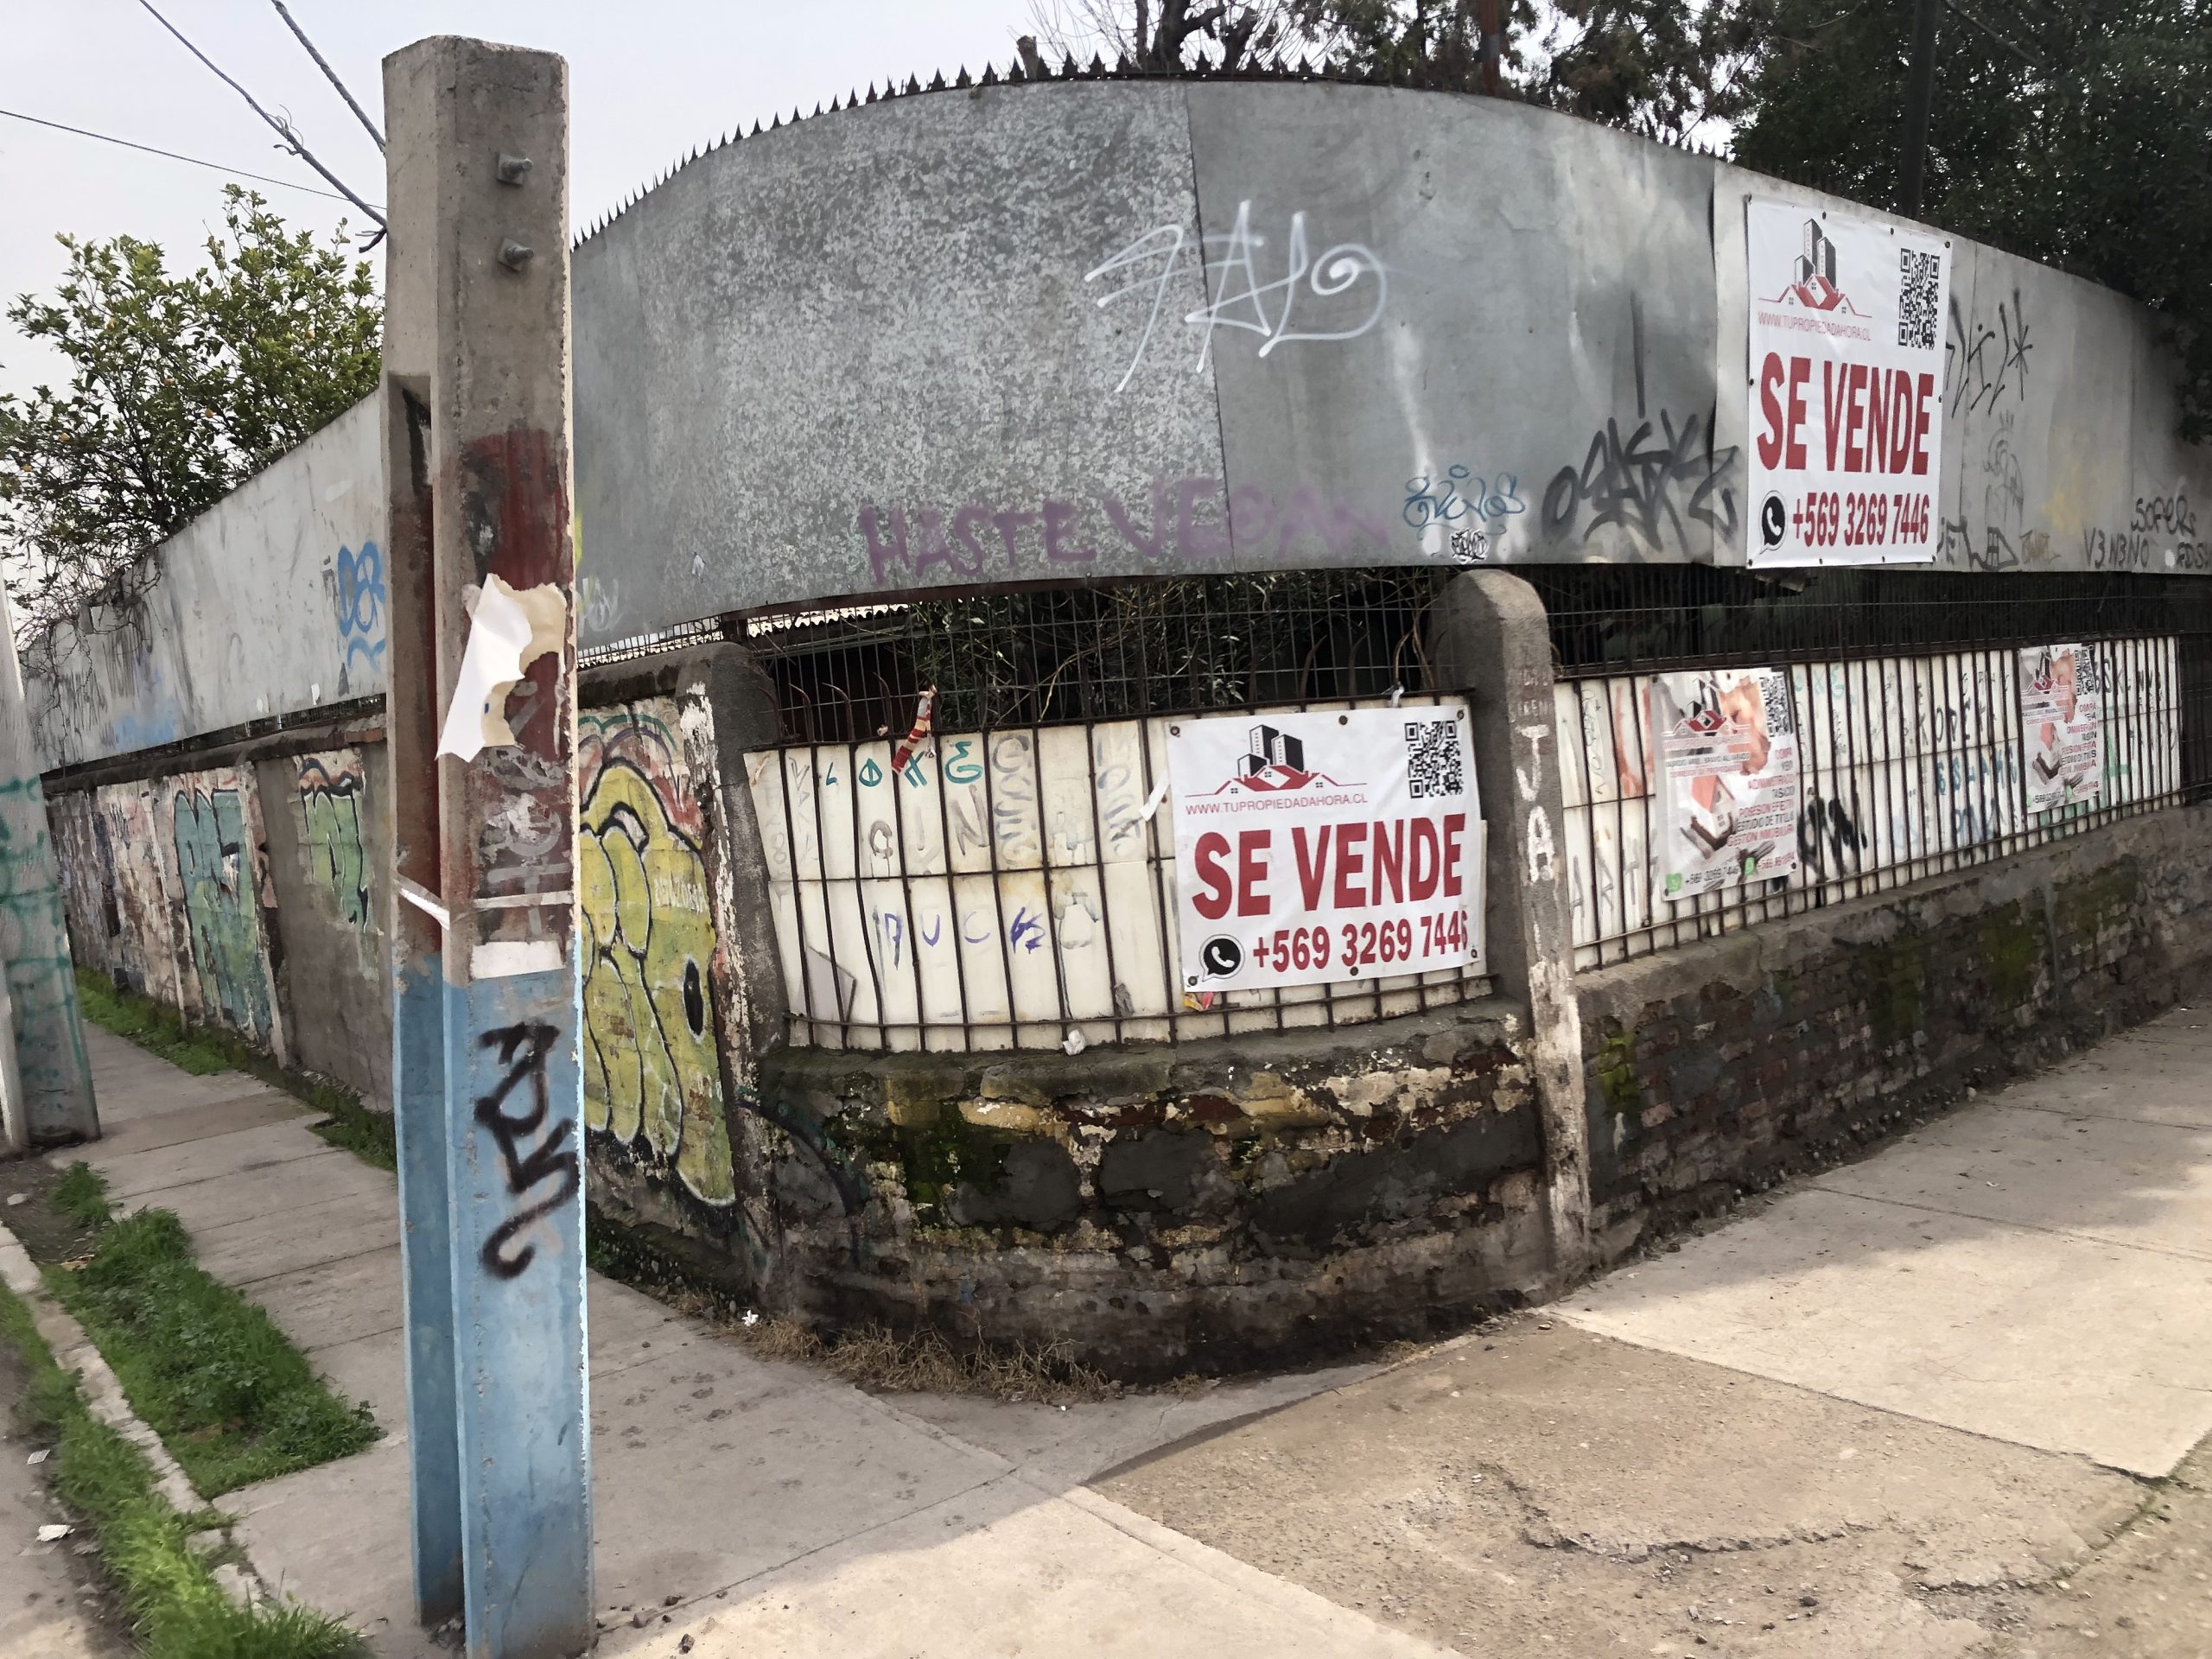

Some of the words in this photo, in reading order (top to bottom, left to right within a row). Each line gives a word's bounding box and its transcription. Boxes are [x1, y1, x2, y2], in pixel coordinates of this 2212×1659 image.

[1758, 311, 1872, 341] WWW.TUPROPIEDADAHORA.CL
[1757, 352, 1812, 471] SE
[1823, 359, 1935, 476] VENDE
[1793, 491, 1840, 548] +569
[1844, 491, 1888, 547] 3269
[1891, 492, 1930, 544] 7446
[1185, 793, 1369, 816] WWW.TUPROPIEDADAHORA.CL
[1192, 829, 1272, 920] SE
[1292, 813, 1466, 912] VENDE
[1253, 925, 1331, 973] +569
[1341, 918, 1412, 967] 3269
[1420, 910, 1468, 958] 7446
